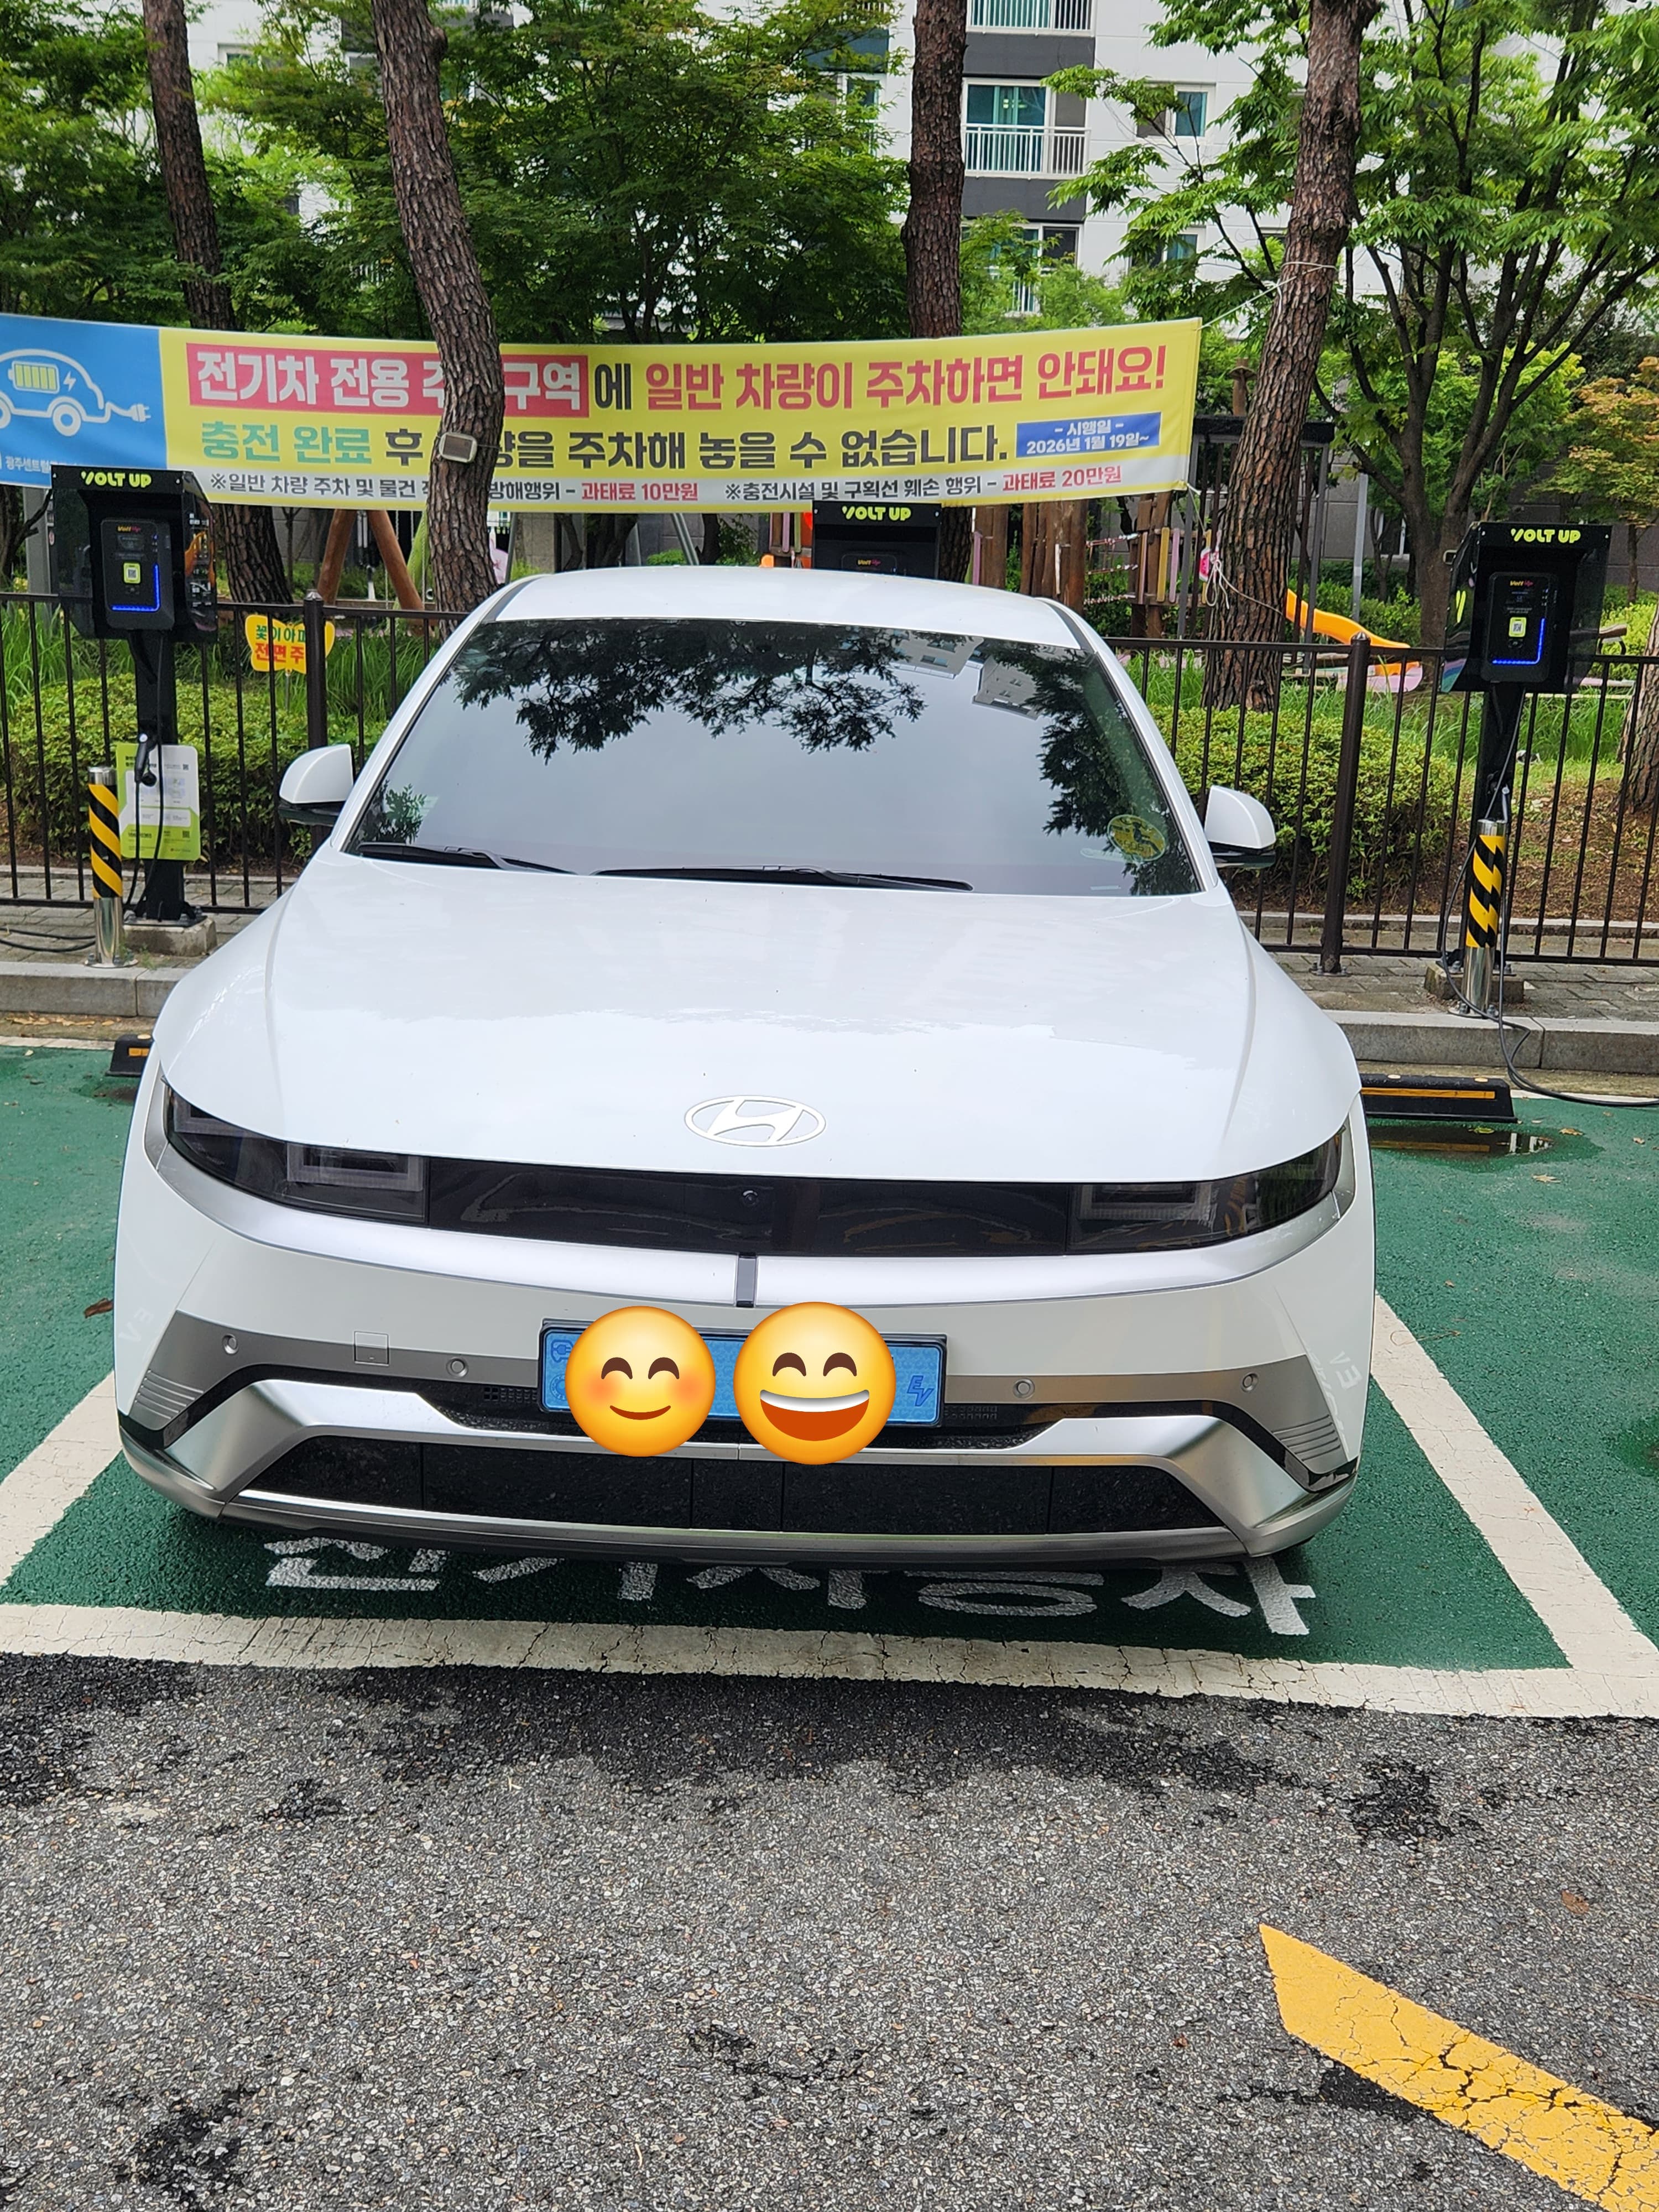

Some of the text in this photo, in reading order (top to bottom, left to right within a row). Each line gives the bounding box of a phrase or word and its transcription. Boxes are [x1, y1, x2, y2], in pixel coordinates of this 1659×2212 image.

[197, 351, 319, 405] 전기차
[331, 358, 409, 408] 전용
[645, 362, 723, 411] 일반
[735, 361, 852, 411] 차량이
[866, 354, 1023, 408] 주차하면
[1037, 345, 1167, 401] 안돼요!
[1067, 419, 1112, 436] 시행일
[201, 420, 280, 462] 충전
[293, 425, 372, 465] 완료
[385, 428, 424, 467] 후
[568, 431, 686, 469] 주차해
[698, 431, 776, 469] 놓을
[789, 431, 827, 469] 수
[841, 424, 1008, 469] 없습니다.
[1026, 436, 1082, 455] 2026년
[1084, 435, 1106, 451] 1월
[81, 471, 152, 488] VOLT UP
[271, 476, 308, 495] 차량
[314, 477, 351, 497] 주차
[356, 479, 374, 498] 및
[379, 479, 416, 498] 물건
[581, 482, 635, 501] 과태료
[641, 482, 699, 502] 10만원
[821, 482, 839, 500] 및
[844, 479, 899, 499] 구획선
[903, 478, 941, 498] 훼손
[945, 476, 982, 496] 행위
[1002, 471, 1056, 492] 과태료
[1061, 466, 1121, 488] 20만원
[842, 506, 911, 520] VOLT UP
[1511, 529, 1580, 543] VOLT UP
[906, 1374, 934, 1407] EV
